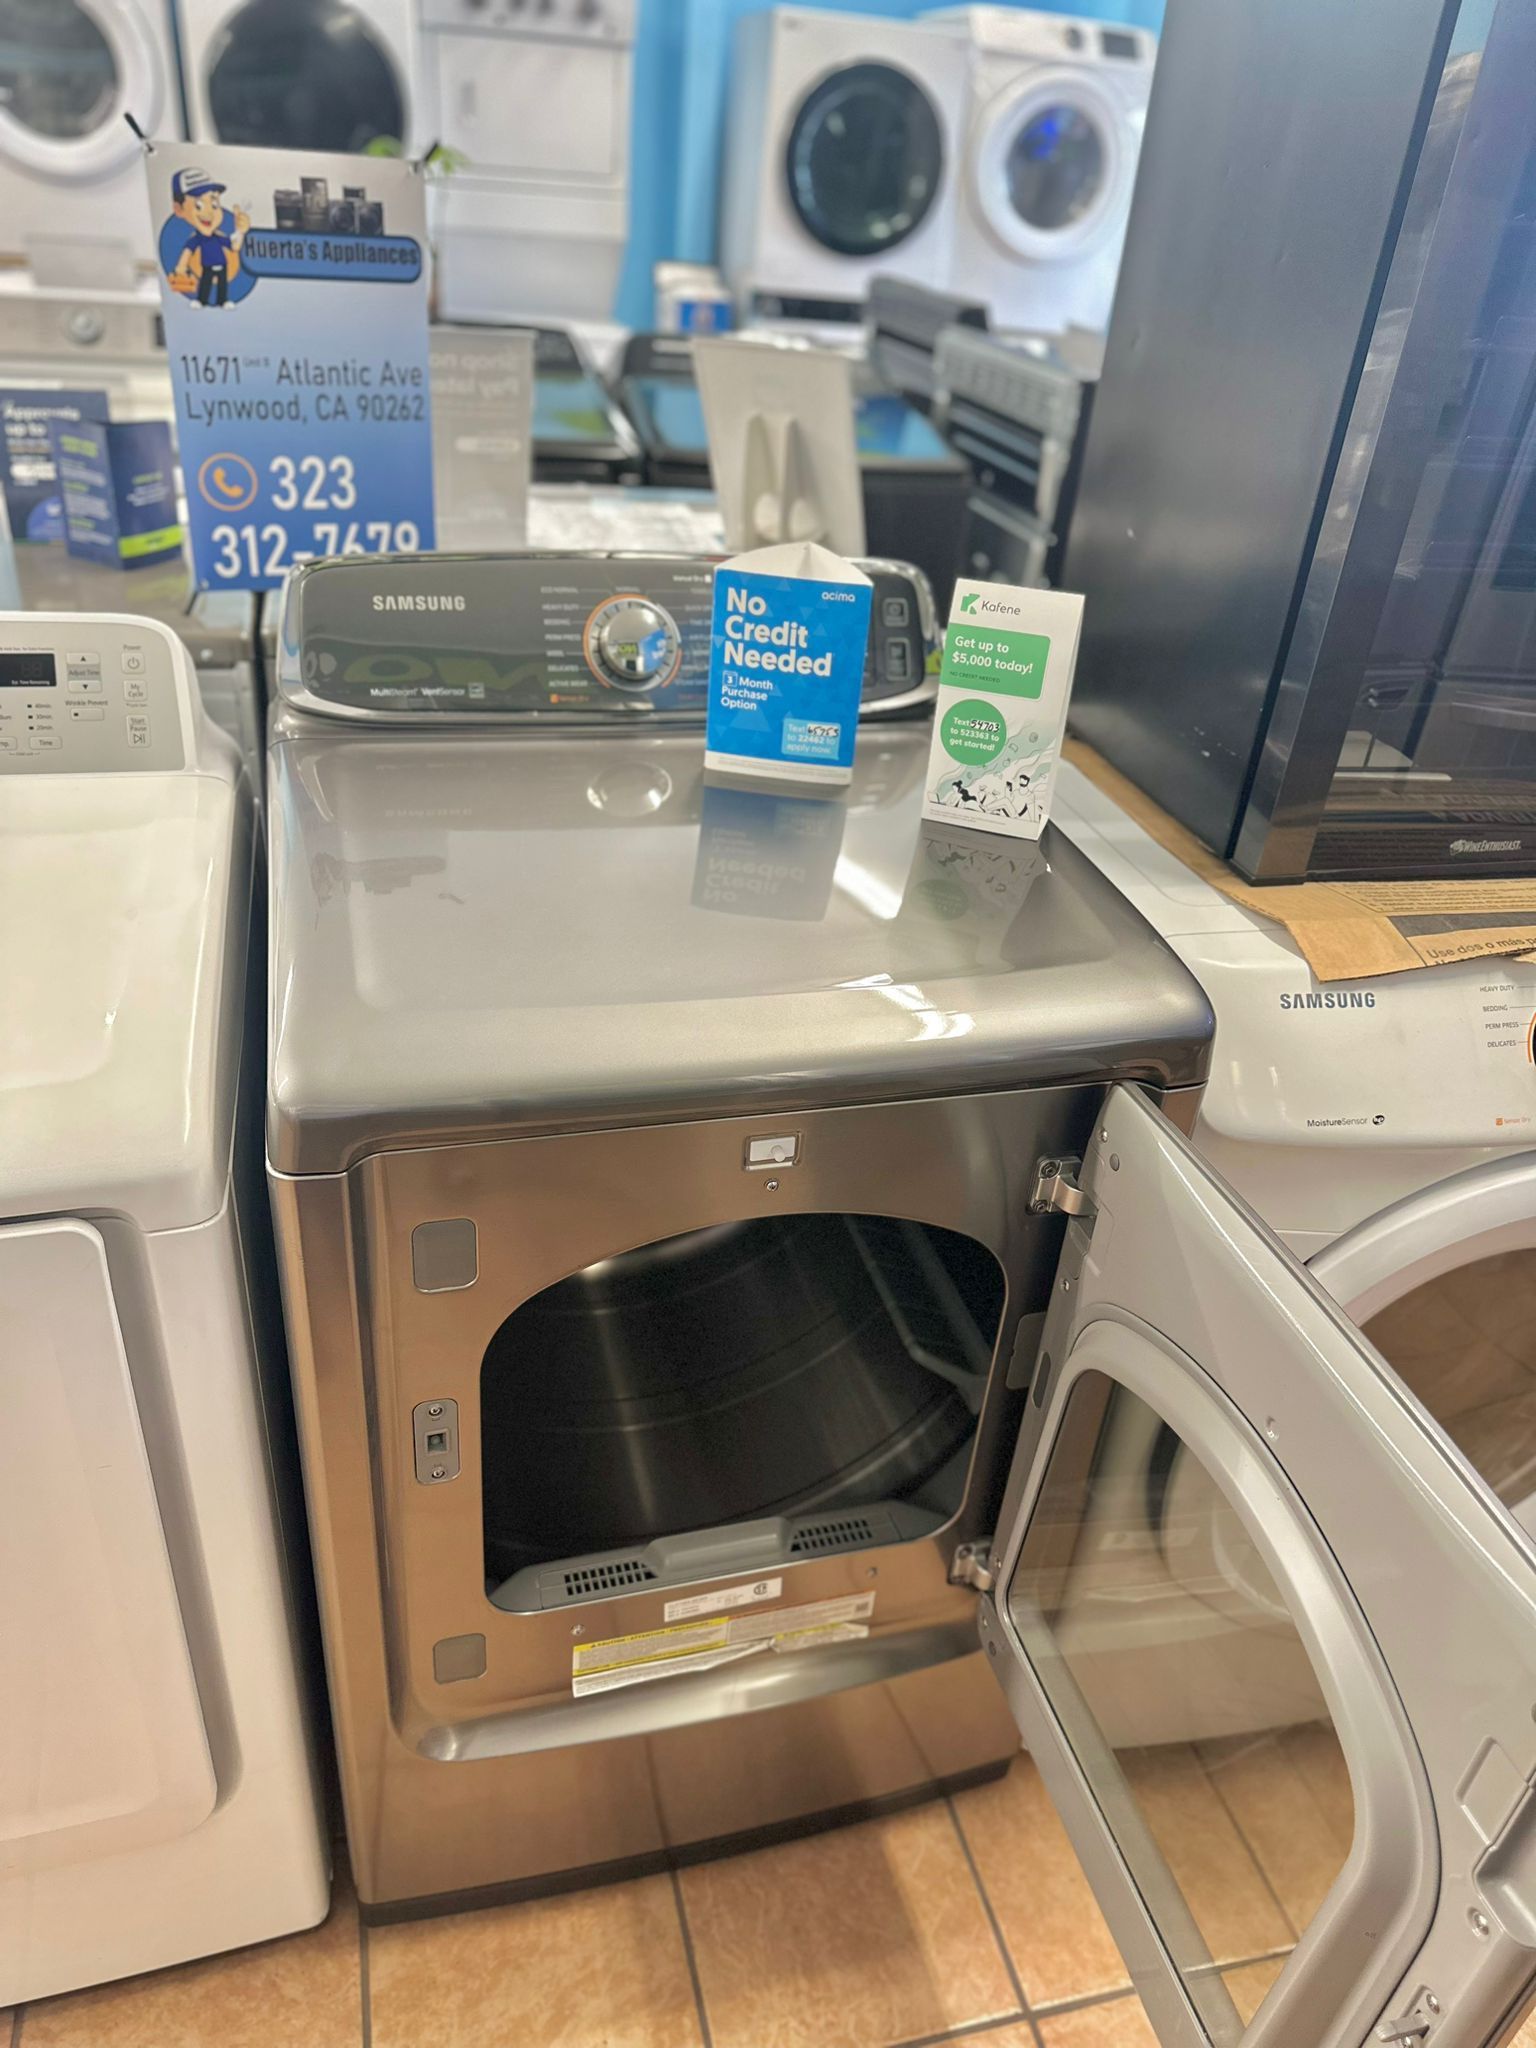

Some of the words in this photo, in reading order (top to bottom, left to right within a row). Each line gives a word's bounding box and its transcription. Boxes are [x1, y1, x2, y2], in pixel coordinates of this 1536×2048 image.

[246, 236, 317, 261] Huerta's
[322, 241, 419, 266] Appliances
[181, 355, 241, 384] 11671
[276, 358, 371, 387] Atlantic
[379, 360, 423, 388] Ave
[185, 391, 308, 428] Lynwood,
[315, 394, 349, 422] CA
[356, 394, 425, 422] 90262
[269, 455, 357, 511] 323
[372, 595, 466, 612] SAMSUNG
[726, 587, 766, 616] No
[821, 591, 856, 602] acima
[981, 600, 1021, 615] Kafene
[724, 615, 808, 648] Credit
[954, 635, 975, 648] Get
[978, 640, 993, 653] up
[996, 642, 1009, 653] to
[723, 641, 833, 677] Needed
[952, 650, 992, 667] $5,000
[994, 658, 1033, 675] today!
[738, 676, 773, 690] Month
[721, 686, 768, 701] Purchase
[720, 697, 757, 711] Option
[953, 716, 970, 726] Text
[949, 738, 962, 746] get
[950, 727, 959, 735] to
[991, 734, 1000, 742] to
[1426, 946, 1456, 959] Use
[1457, 943, 1483, 956] dos
[1497, 937, 1523, 947] más
[1279, 992, 1376, 1009] SAMSUNG
[1482, 1004, 1508, 1012] BEDDING
[1485, 1022, 1501, 1030] PERM
[1501, 1021, 1520, 1029] PRESS
[1487, 1039, 1517, 1048] DELICATES
[1307, 1117, 1368, 1128] MoistureSensor
